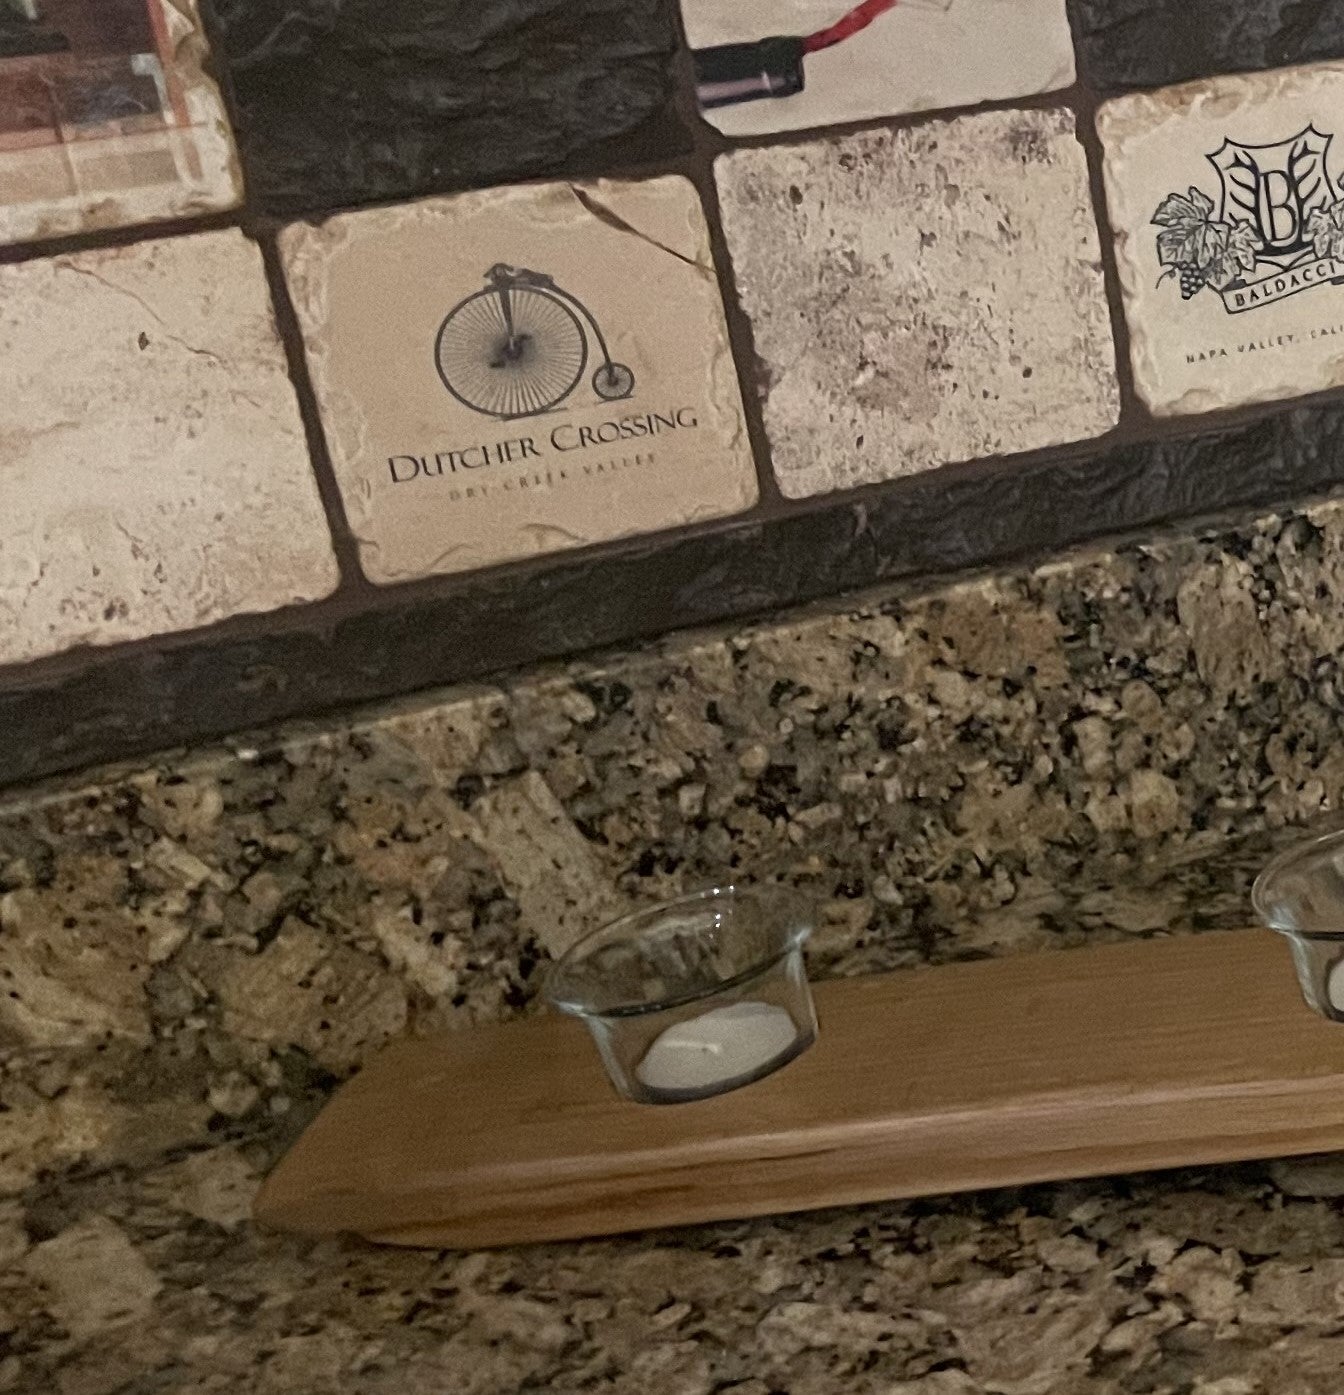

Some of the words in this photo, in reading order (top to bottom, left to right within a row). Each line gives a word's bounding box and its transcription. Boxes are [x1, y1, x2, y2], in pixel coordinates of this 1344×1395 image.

[1259, 168, 1297, 243] B
[1234, 260, 1337, 308] BALDACCI
[1186, 348, 1228, 364] NAPA
[388, 436, 542, 484] DUTCHER
[550, 406, 699, 452] CROSSING
